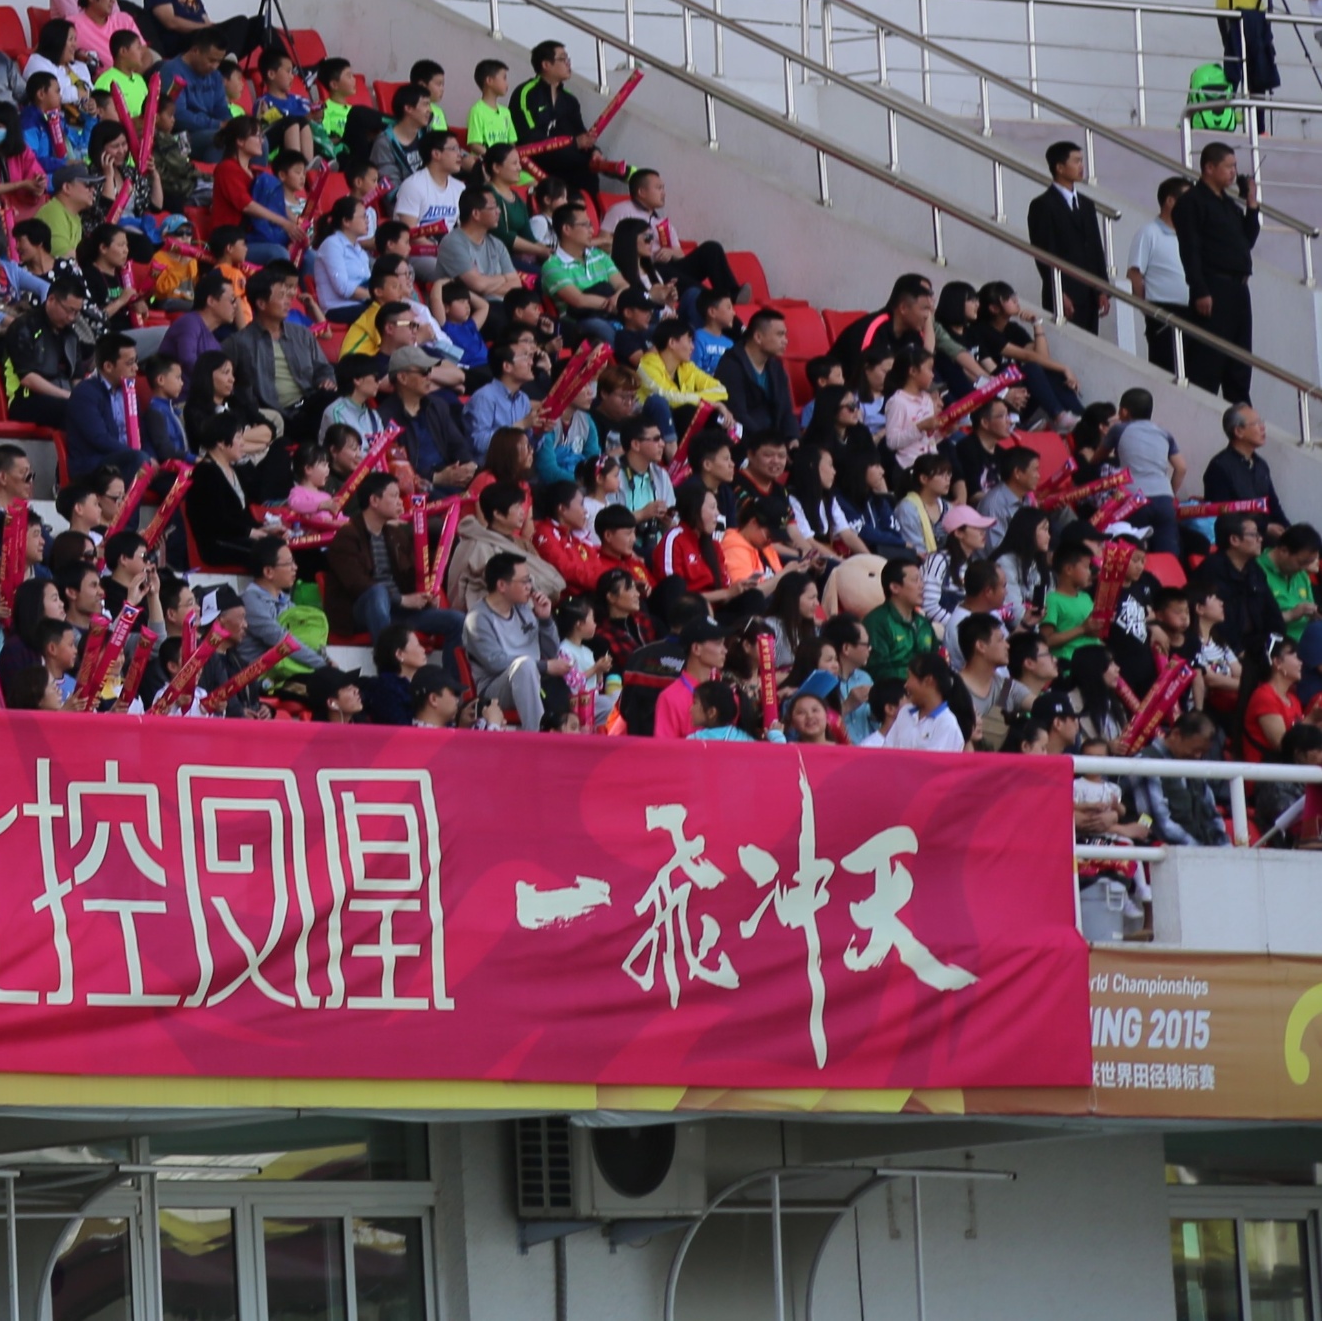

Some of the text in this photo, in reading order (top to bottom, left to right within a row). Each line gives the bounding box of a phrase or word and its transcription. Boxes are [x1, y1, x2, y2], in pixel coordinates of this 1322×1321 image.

[514, 753, 978, 1071] 一飞冲天
[1112, 973, 1210, 1000] Championships
[1147, 1008, 1212, 1050] 2015
